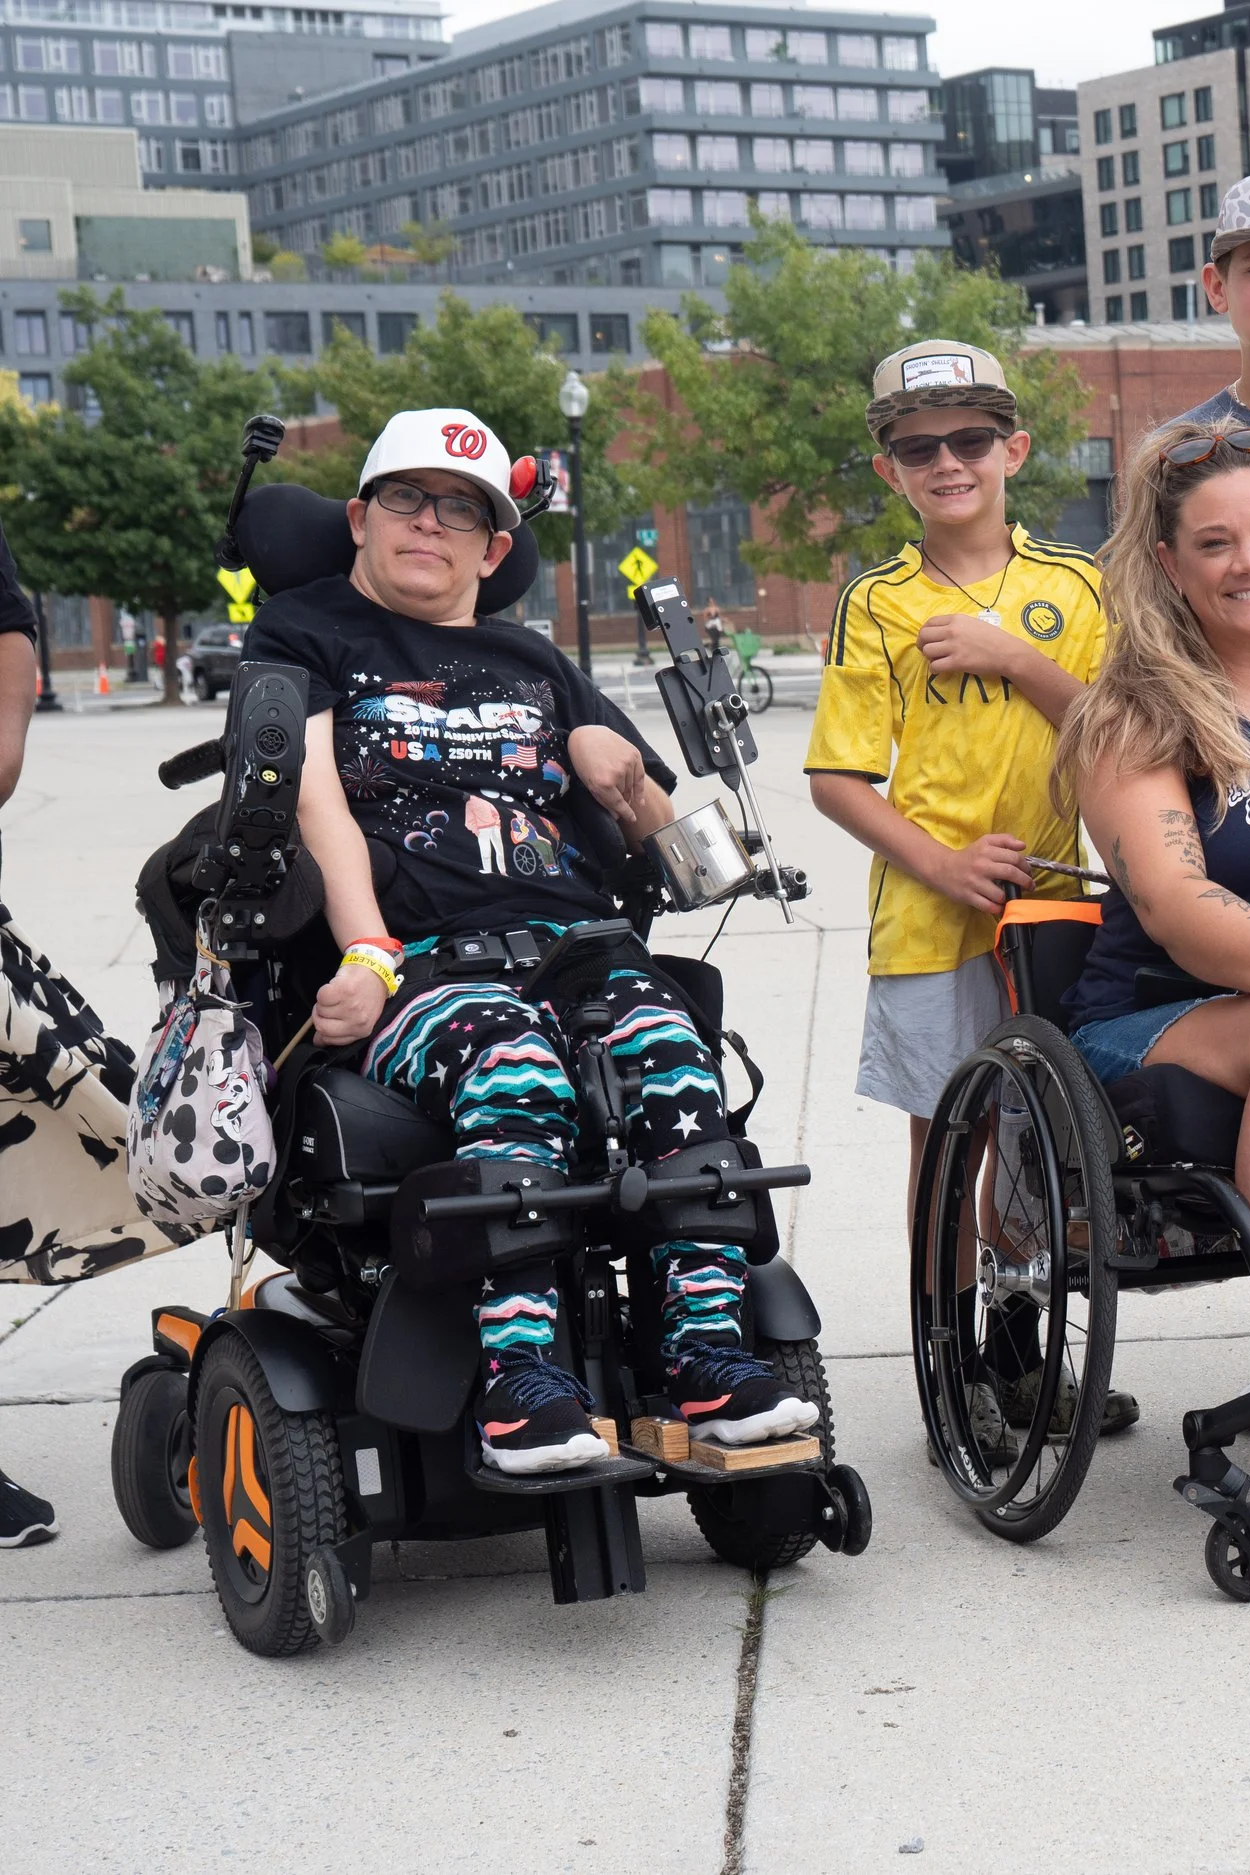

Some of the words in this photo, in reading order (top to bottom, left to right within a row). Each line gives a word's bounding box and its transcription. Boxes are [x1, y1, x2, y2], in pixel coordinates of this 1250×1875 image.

[441, 423, 487, 461] W
[384, 694, 543, 733] SPARC
[404, 724, 440, 738] 20TH
[391, 740, 441, 762] USA
[449, 748, 493, 761] 250TH
[348, 954, 376, 967] ALERT
[378, 965, 391, 982] FALL
